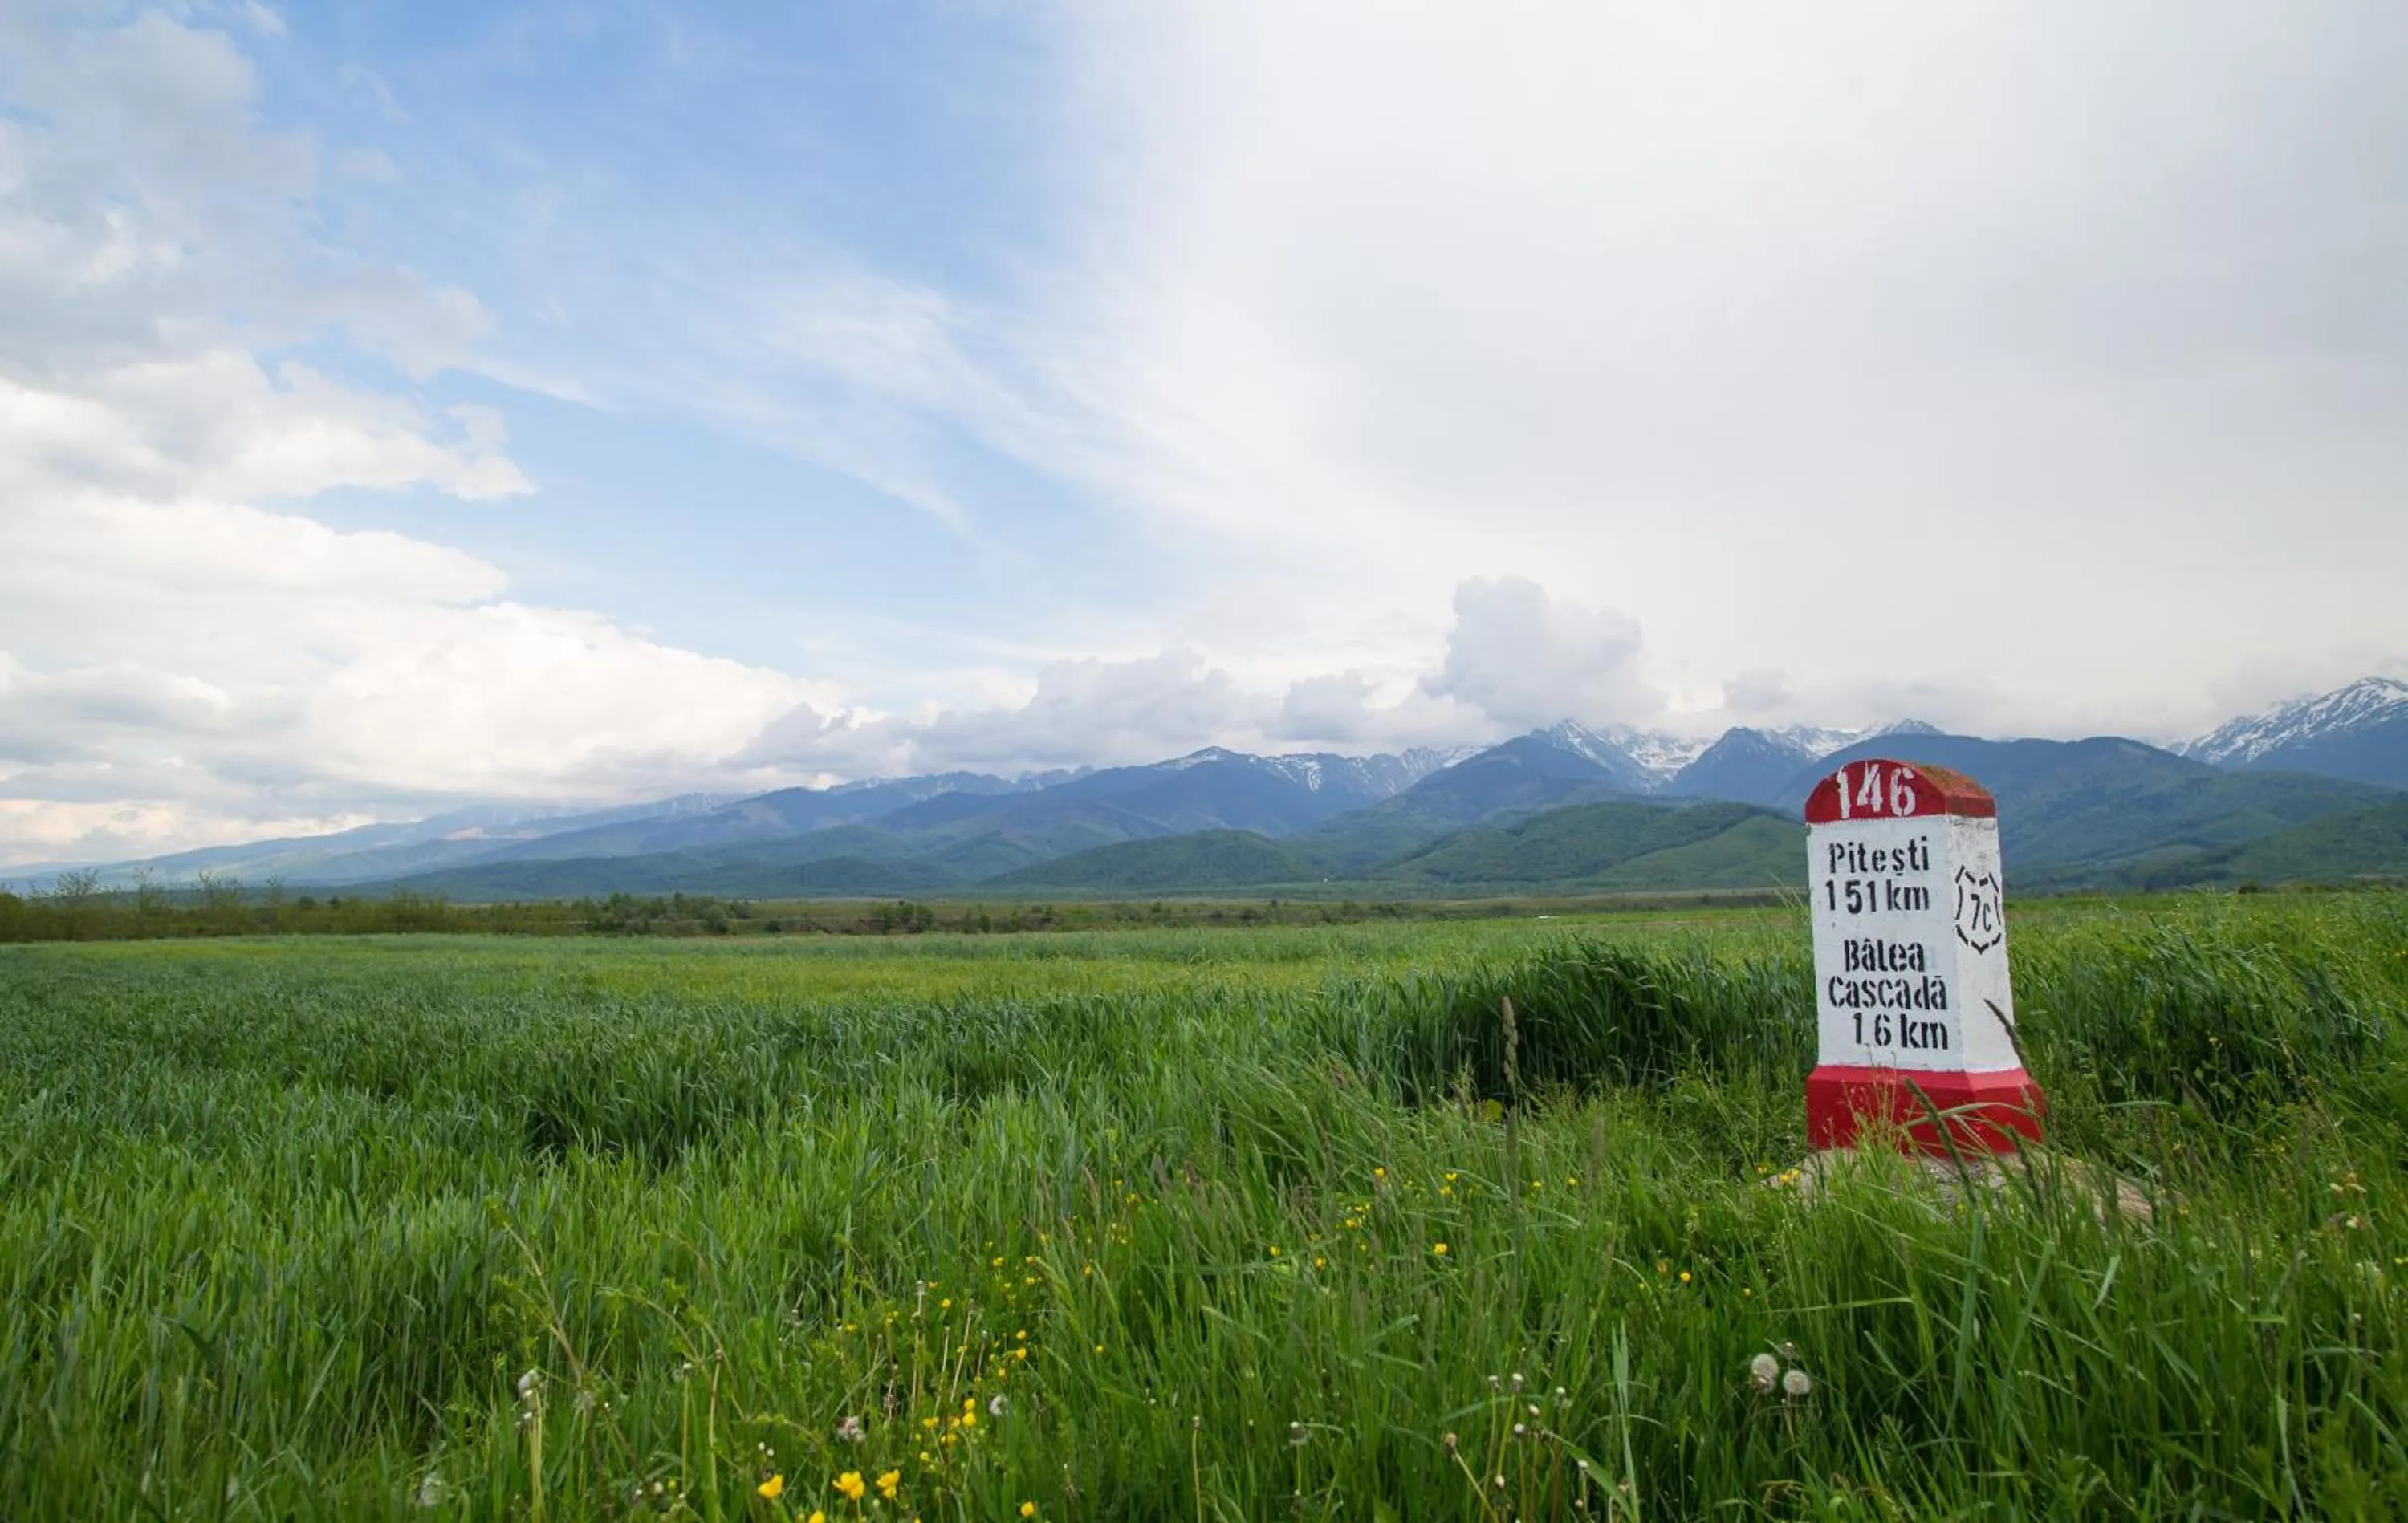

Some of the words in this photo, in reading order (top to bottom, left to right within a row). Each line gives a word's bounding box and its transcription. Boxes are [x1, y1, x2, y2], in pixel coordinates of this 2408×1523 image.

[1836, 762, 1916, 819] 146
[1825, 879, 1877, 915] 151
[1885, 879, 1930, 911] km
[1844, 938, 1925, 973] Bâlea
[1853, 1012, 1892, 1046] 16
[1900, 1013, 1949, 1050] km
